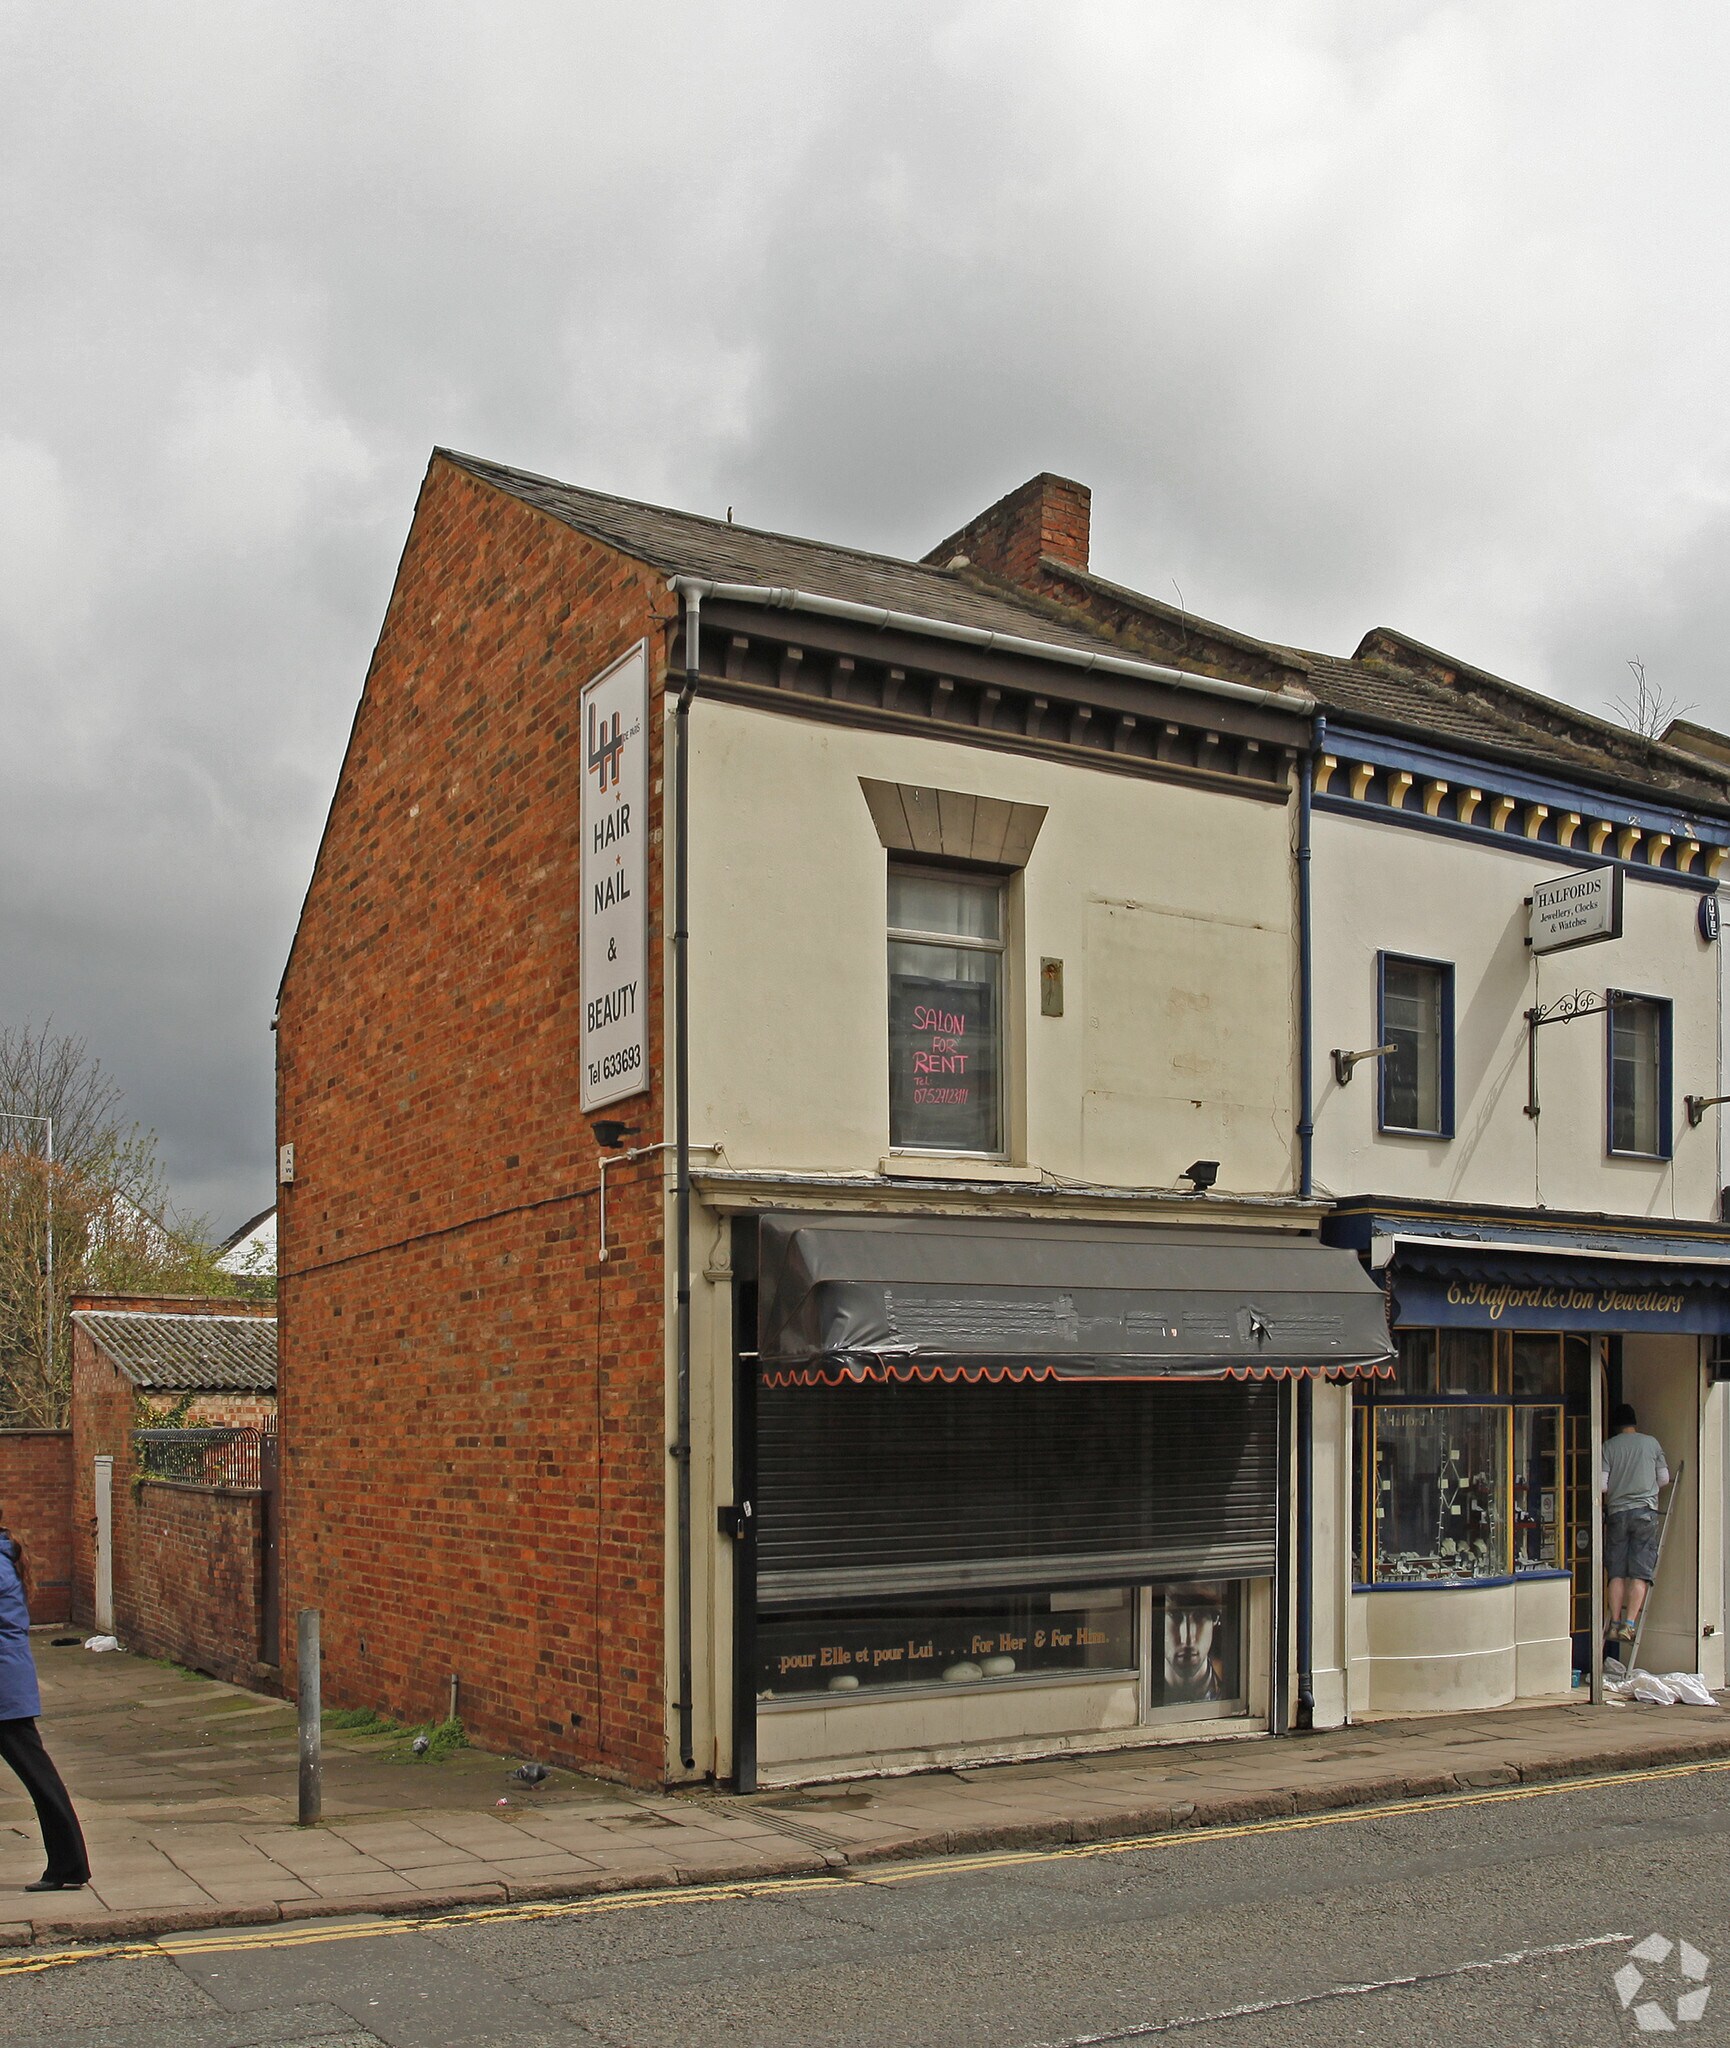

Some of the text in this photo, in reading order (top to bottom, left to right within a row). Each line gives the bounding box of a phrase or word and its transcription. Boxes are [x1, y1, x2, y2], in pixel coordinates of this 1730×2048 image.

[594, 803, 630, 854] HAIR
[595, 868, 631, 915] NAIL
[1539, 879, 1601, 908] HALFORDS
[1540, 900, 1599, 923] Jewellery, Clocks
[1550, 917, 1588, 934] & Watches
[607, 936, 618, 962] &
[587, 981, 638, 1033] BEAUTY
[912, 1005, 965, 1035] SALON
[932, 1036, 957, 1053] FOR
[588, 1044, 641, 1087] Tel 633693
[912, 1051, 968, 1074] RENT
[1598, 1290, 1685, 1313] Jewellers
[820, 1646, 851, 1667] Elle
[855, 1646, 870, 1663] et
[873, 1647, 904, 1667] pour
[907, 1639, 934, 1660] Lui
[999, 1632, 1027, 1652] Her
[1034, 1629, 1047, 1648] &
